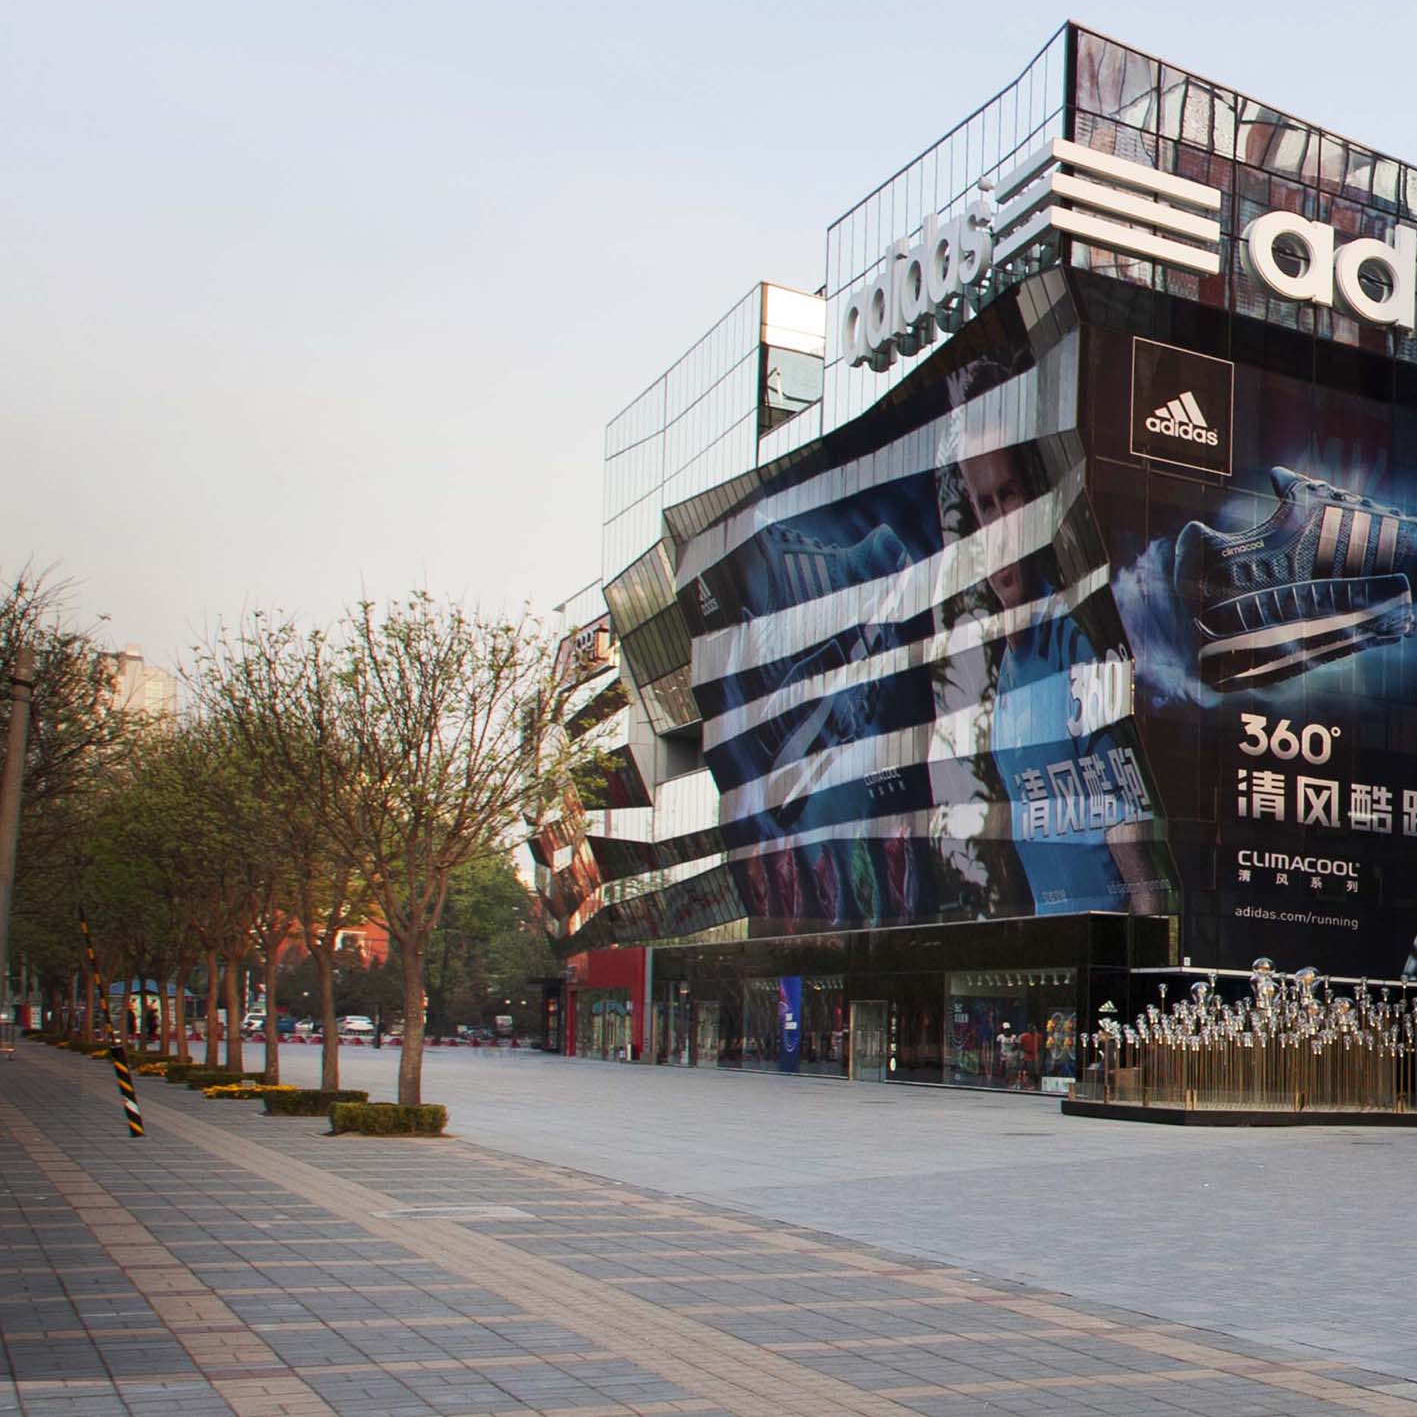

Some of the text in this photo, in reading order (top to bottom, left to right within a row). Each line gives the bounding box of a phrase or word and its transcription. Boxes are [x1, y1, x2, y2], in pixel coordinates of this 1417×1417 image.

[841, 199, 993, 373] adidas
[1145, 416, 1219, 447] adidas
[1221, 538, 1265, 558] climacool
[1015, 747, 1155, 841] 清风酷跑
[1238, 849, 1361, 878] CLIMACOOL
[1238, 870, 1359, 893] 清风系列
[1235, 906, 1359, 930] adidas.com/running
